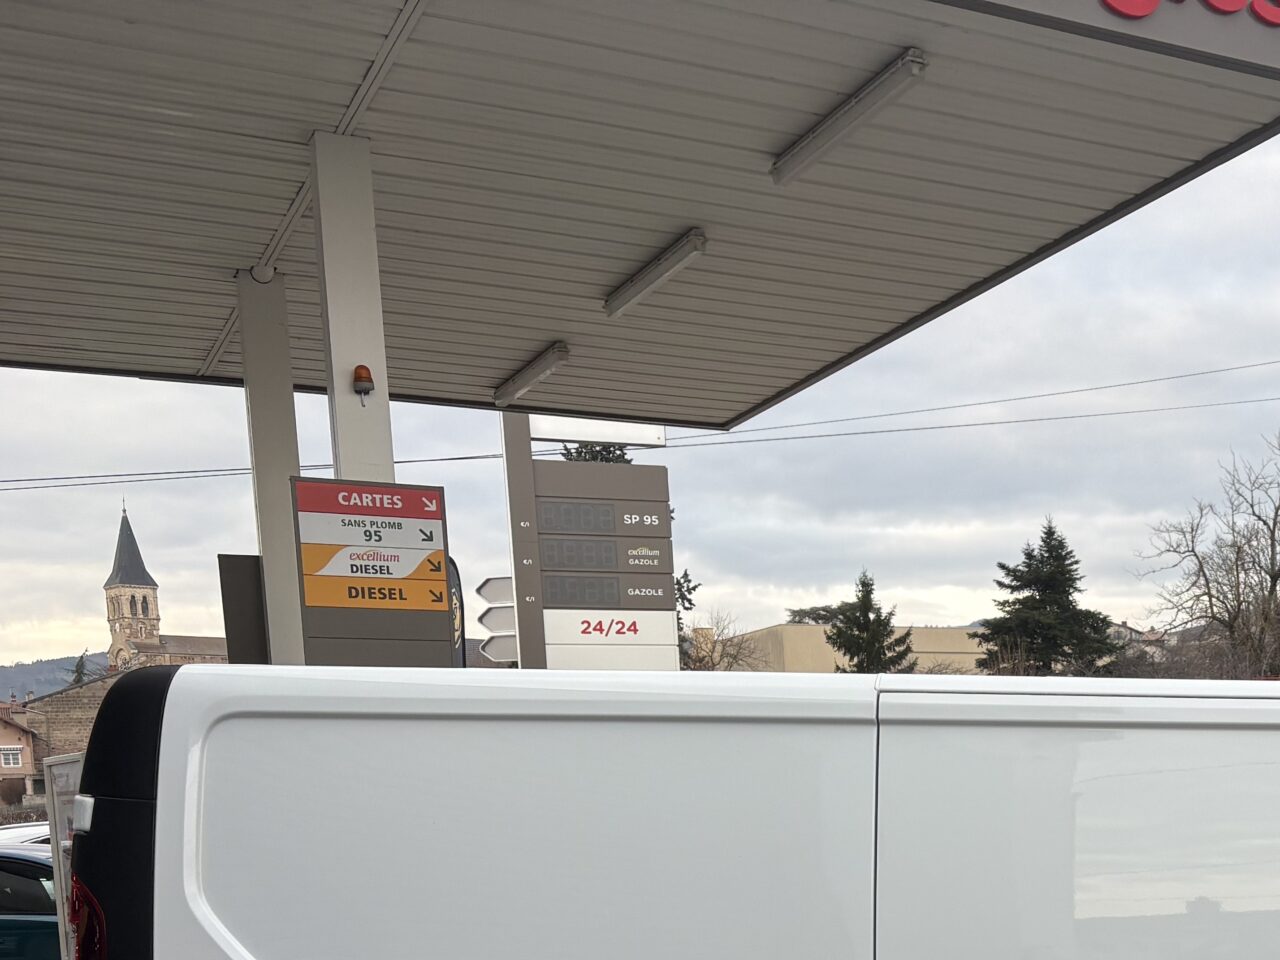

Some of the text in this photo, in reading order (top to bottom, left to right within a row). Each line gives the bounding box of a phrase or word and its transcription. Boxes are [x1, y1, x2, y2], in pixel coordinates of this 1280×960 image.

[338, 492, 403, 509] CARTES
[341, 518, 403, 530] SANS PLOMB
[623, 514, 659, 525] SP 95
[363, 530, 383, 542] 95
[349, 550, 400, 563] excellium
[628, 558, 659, 566] GAZOLE
[350, 563, 394, 575] DIESEL
[348, 586, 408, 601] DIESEL
[627, 588, 664, 596] GAZOLE
[580, 619, 639, 637] 24/24
